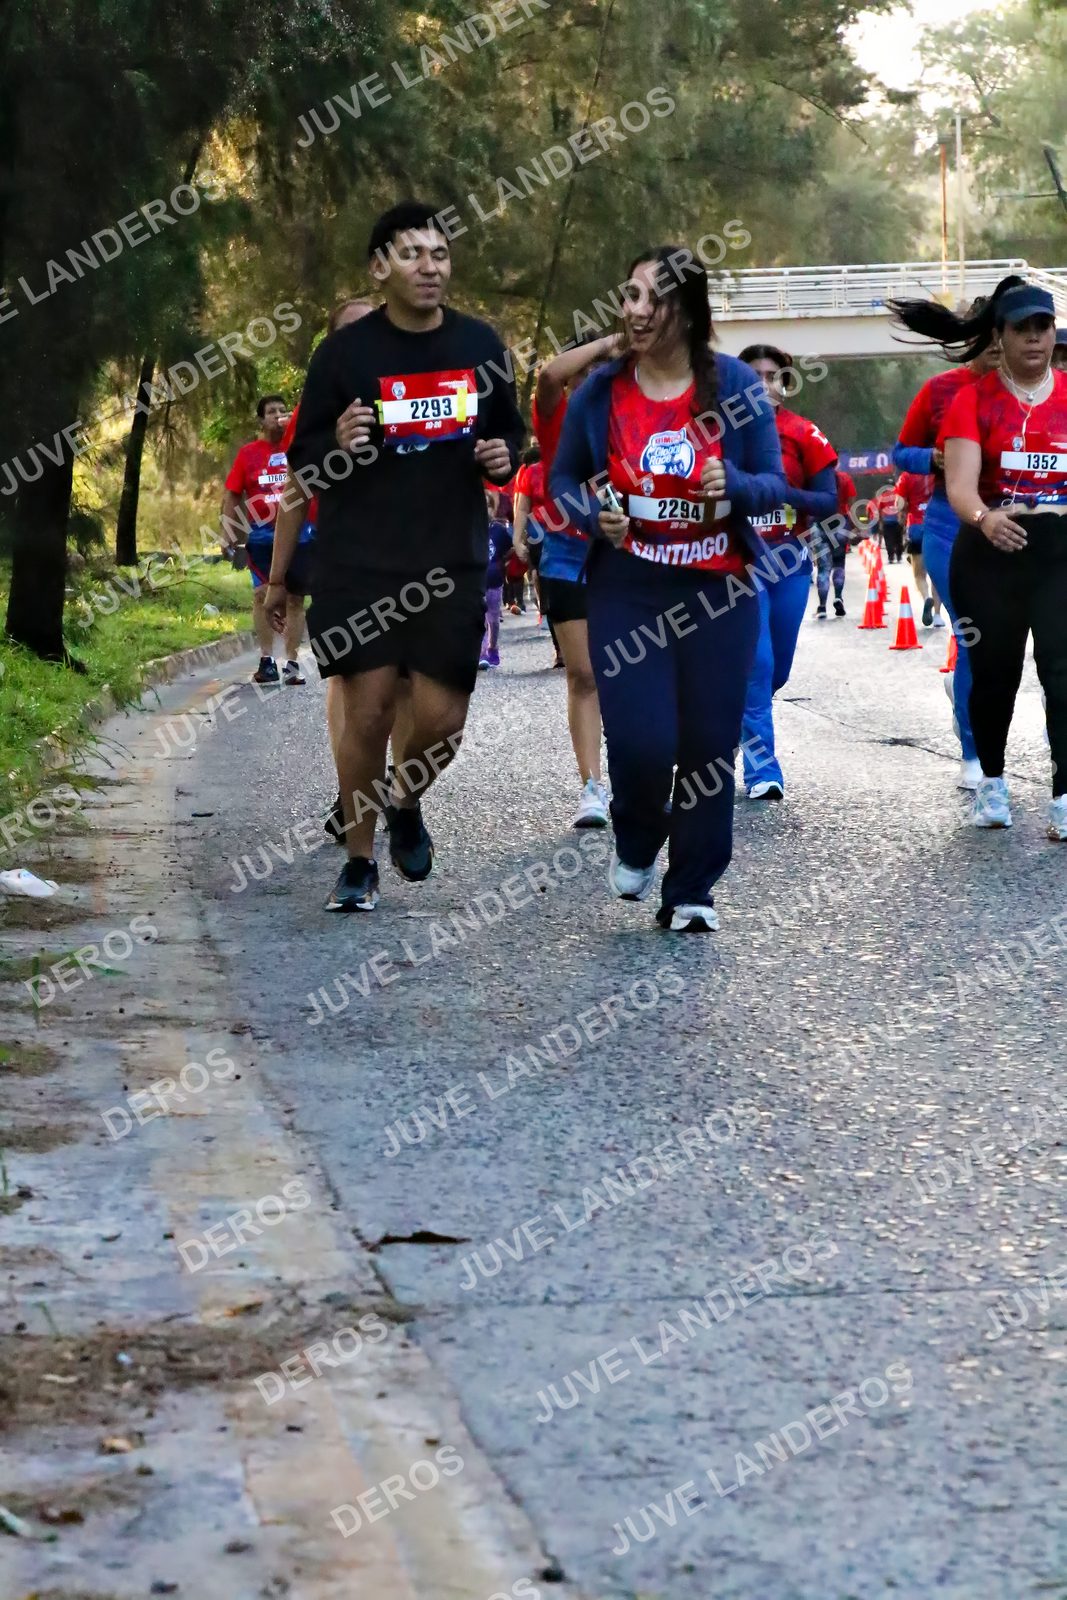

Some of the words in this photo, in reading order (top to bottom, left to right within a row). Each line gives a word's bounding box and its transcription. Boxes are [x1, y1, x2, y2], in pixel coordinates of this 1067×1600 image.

[411, 397, 452, 419] 2293
[849, 456, 869, 468] 5K
[1027, 453, 1058, 470] 1352
[657, 499, 701, 521] 2294
[631, 532, 729, 565] SANTIAGO
